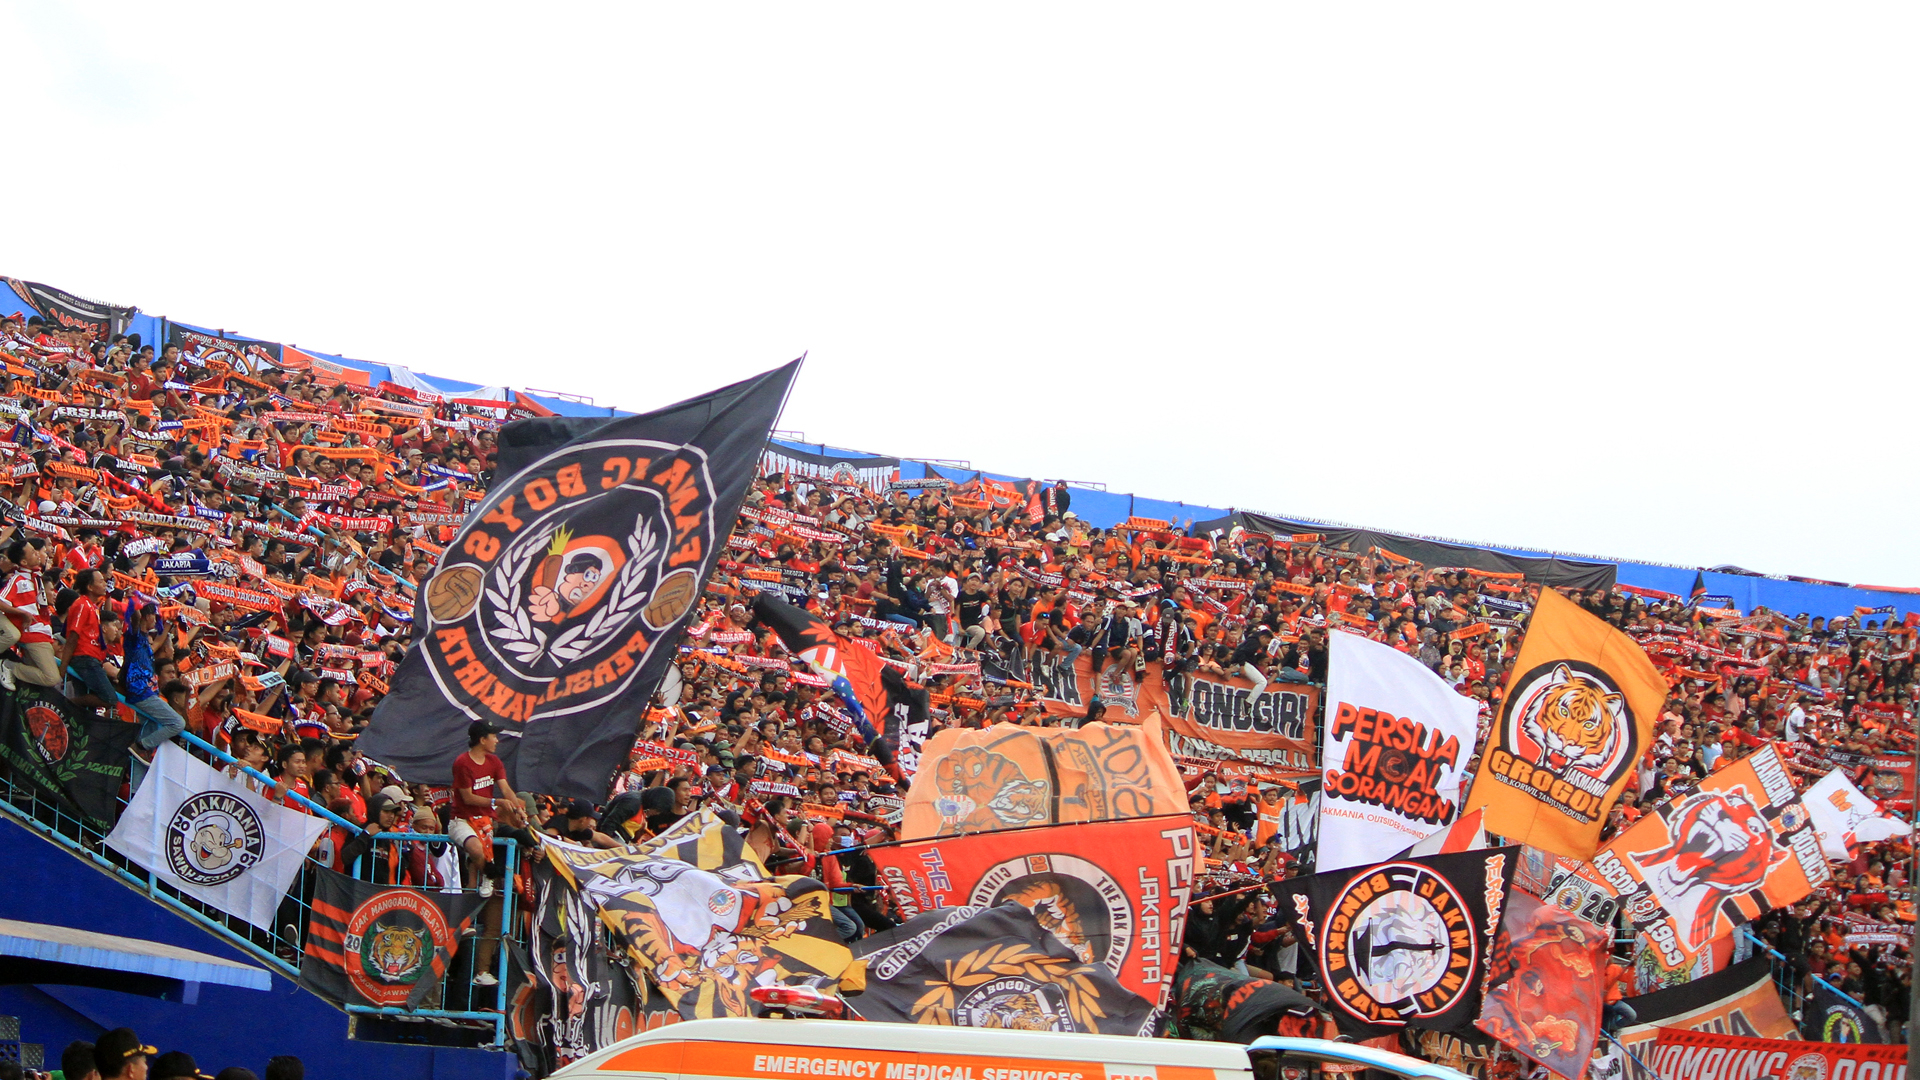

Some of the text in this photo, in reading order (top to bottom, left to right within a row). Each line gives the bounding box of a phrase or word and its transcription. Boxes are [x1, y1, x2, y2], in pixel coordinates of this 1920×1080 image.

[337, 418, 383, 435] PERSIJA
[115, 458, 148, 473] JAKARTA
[176, 517, 211, 531] KUDUS
[347, 519, 379, 532] JAKARTA
[161, 559, 191, 569] JAKARTA
[205, 584, 270, 606] PERSIJA JAKARTA
[1208, 579, 1246, 590] PERSIJA
[635, 740, 698, 763] PERSIJA
[1331, 701, 1460, 771] PERSIJA
[1491, 750, 1602, 819] GROGOL
[1563, 768, 1611, 798] JAKMANIA
[1750, 743, 1796, 808] WAROENG
[1324, 769, 1455, 823] SORANGAN
[1827, 788, 1852, 812] the
[174, 816, 191, 832] 20
[189, 796, 261, 849] JAKMANIA
[172, 835, 198, 881] SAWAH
[919, 847, 953, 892] THE
[354, 897, 444, 944] JAK MANGGADUA SELATAN
[1096, 876, 1121, 904] THE
[1112, 905, 1128, 931] JAK
[1580, 891, 1617, 926] 28
[347, 935, 361, 950] 20
[1138, 866, 1163, 984] JAKARTA
[1328, 873, 1401, 1021] BANGKA RAYA
[1419, 877, 1471, 1010] JAKMANIA
[1644, 919, 1685, 967] 1969
[753, 1054, 881, 1077] EMERGENCY
[885, 1062, 974, 1080] MEDICAL
